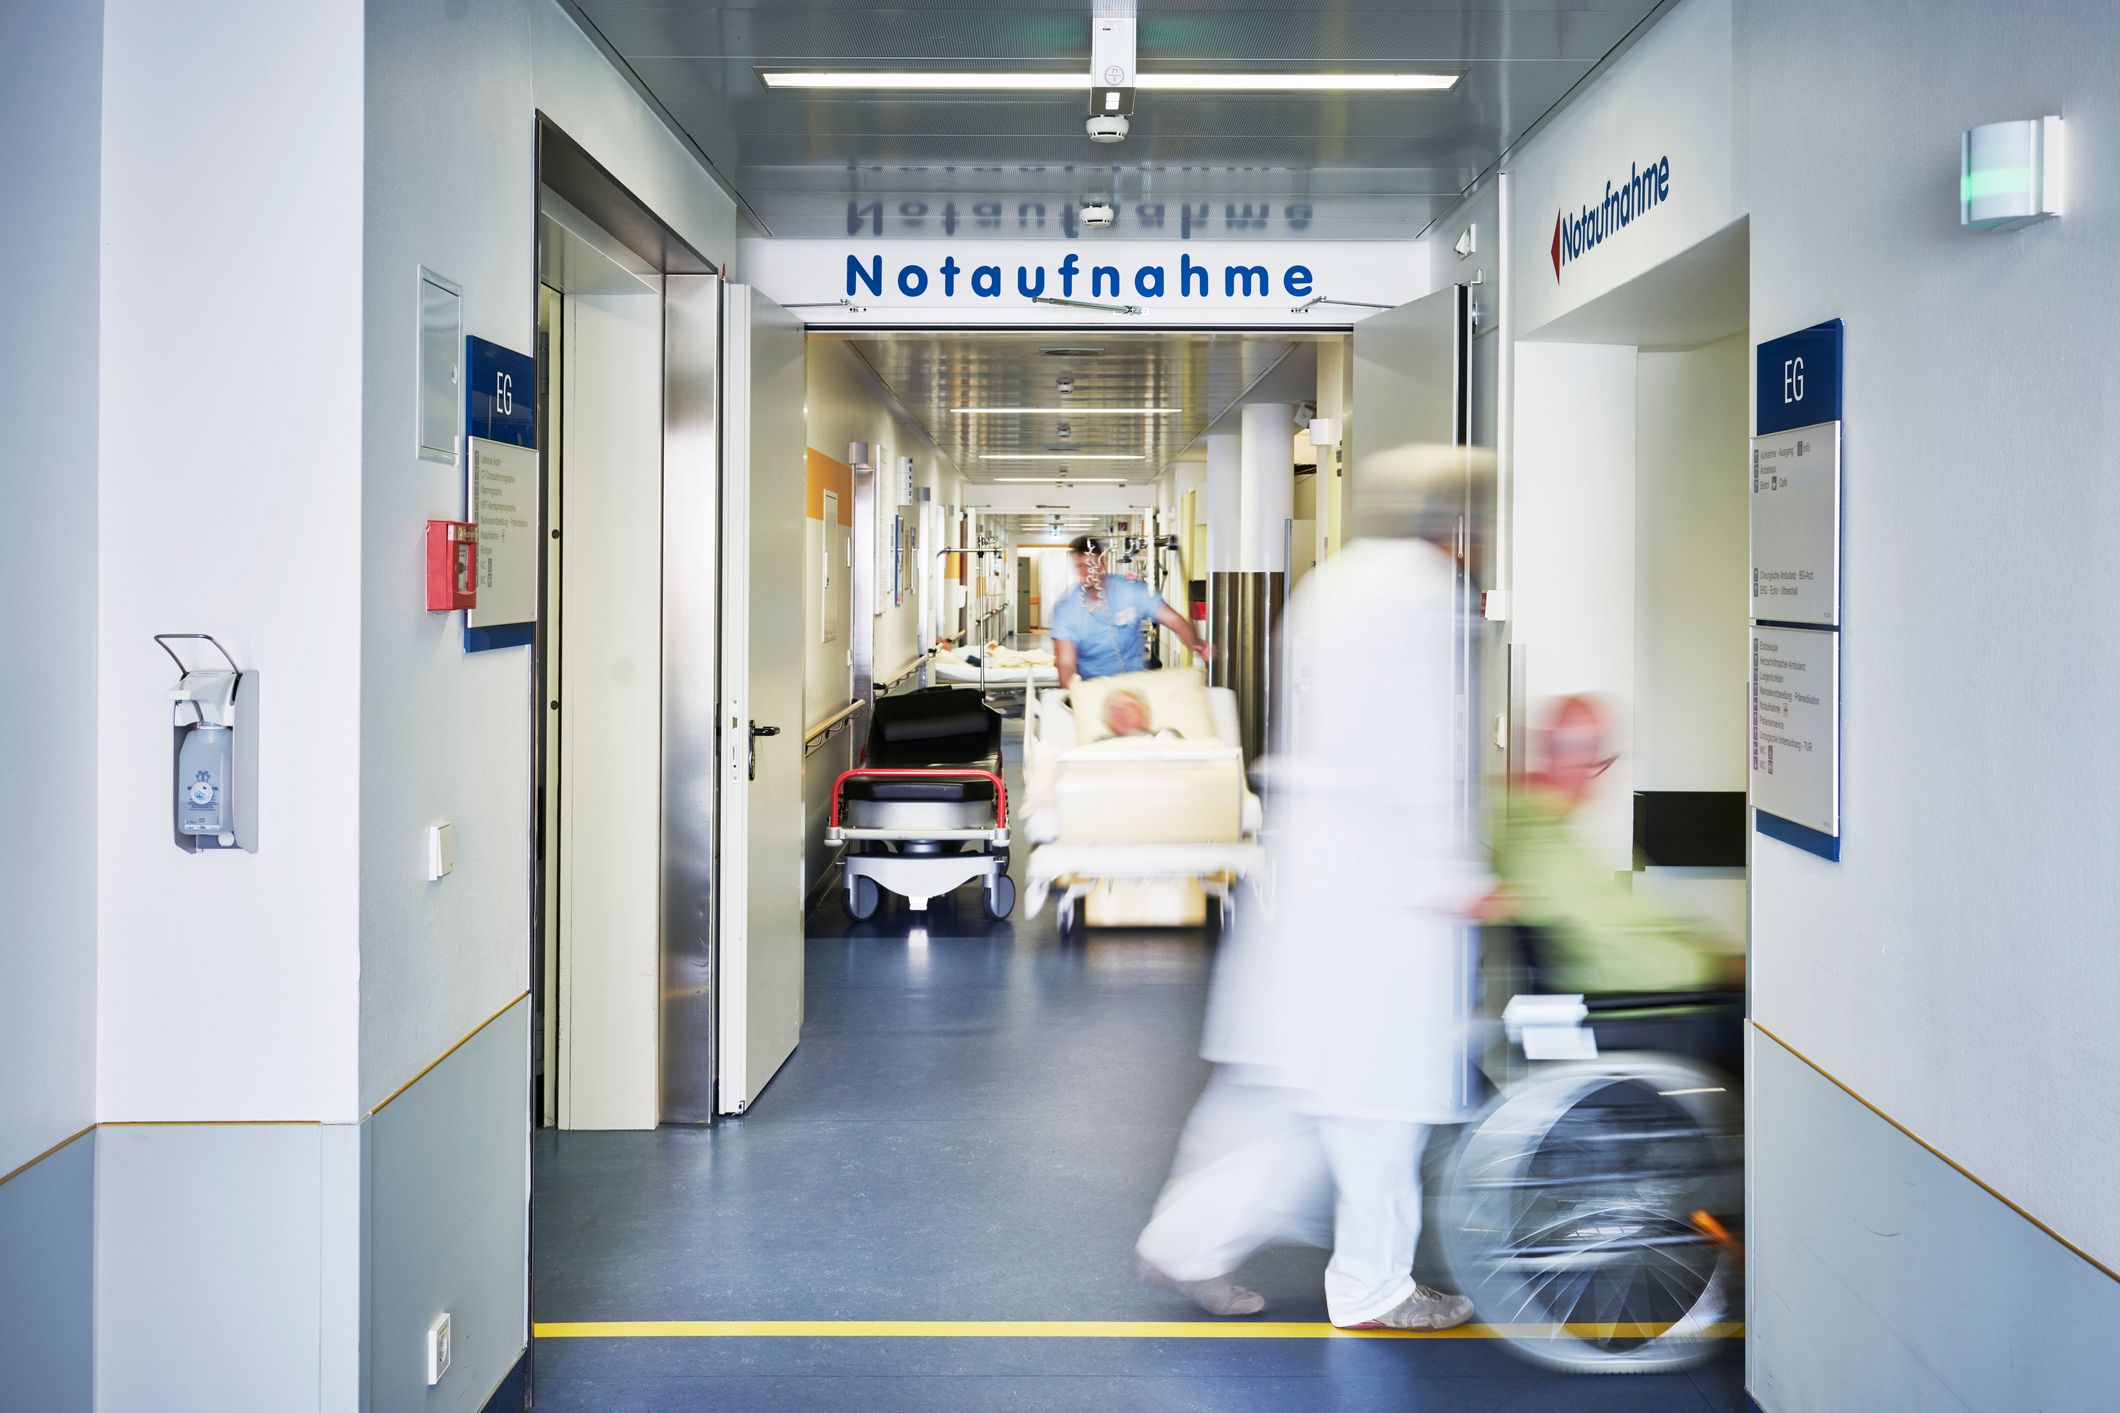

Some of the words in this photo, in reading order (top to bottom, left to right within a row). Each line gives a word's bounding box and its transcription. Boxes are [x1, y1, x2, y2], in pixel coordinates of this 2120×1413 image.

[1562, 155, 1670, 267] Notaufnahme
[846, 253, 1313, 297] Notaufnahme
[496, 371, 512, 416] EG
[1784, 356, 1804, 405] EG
